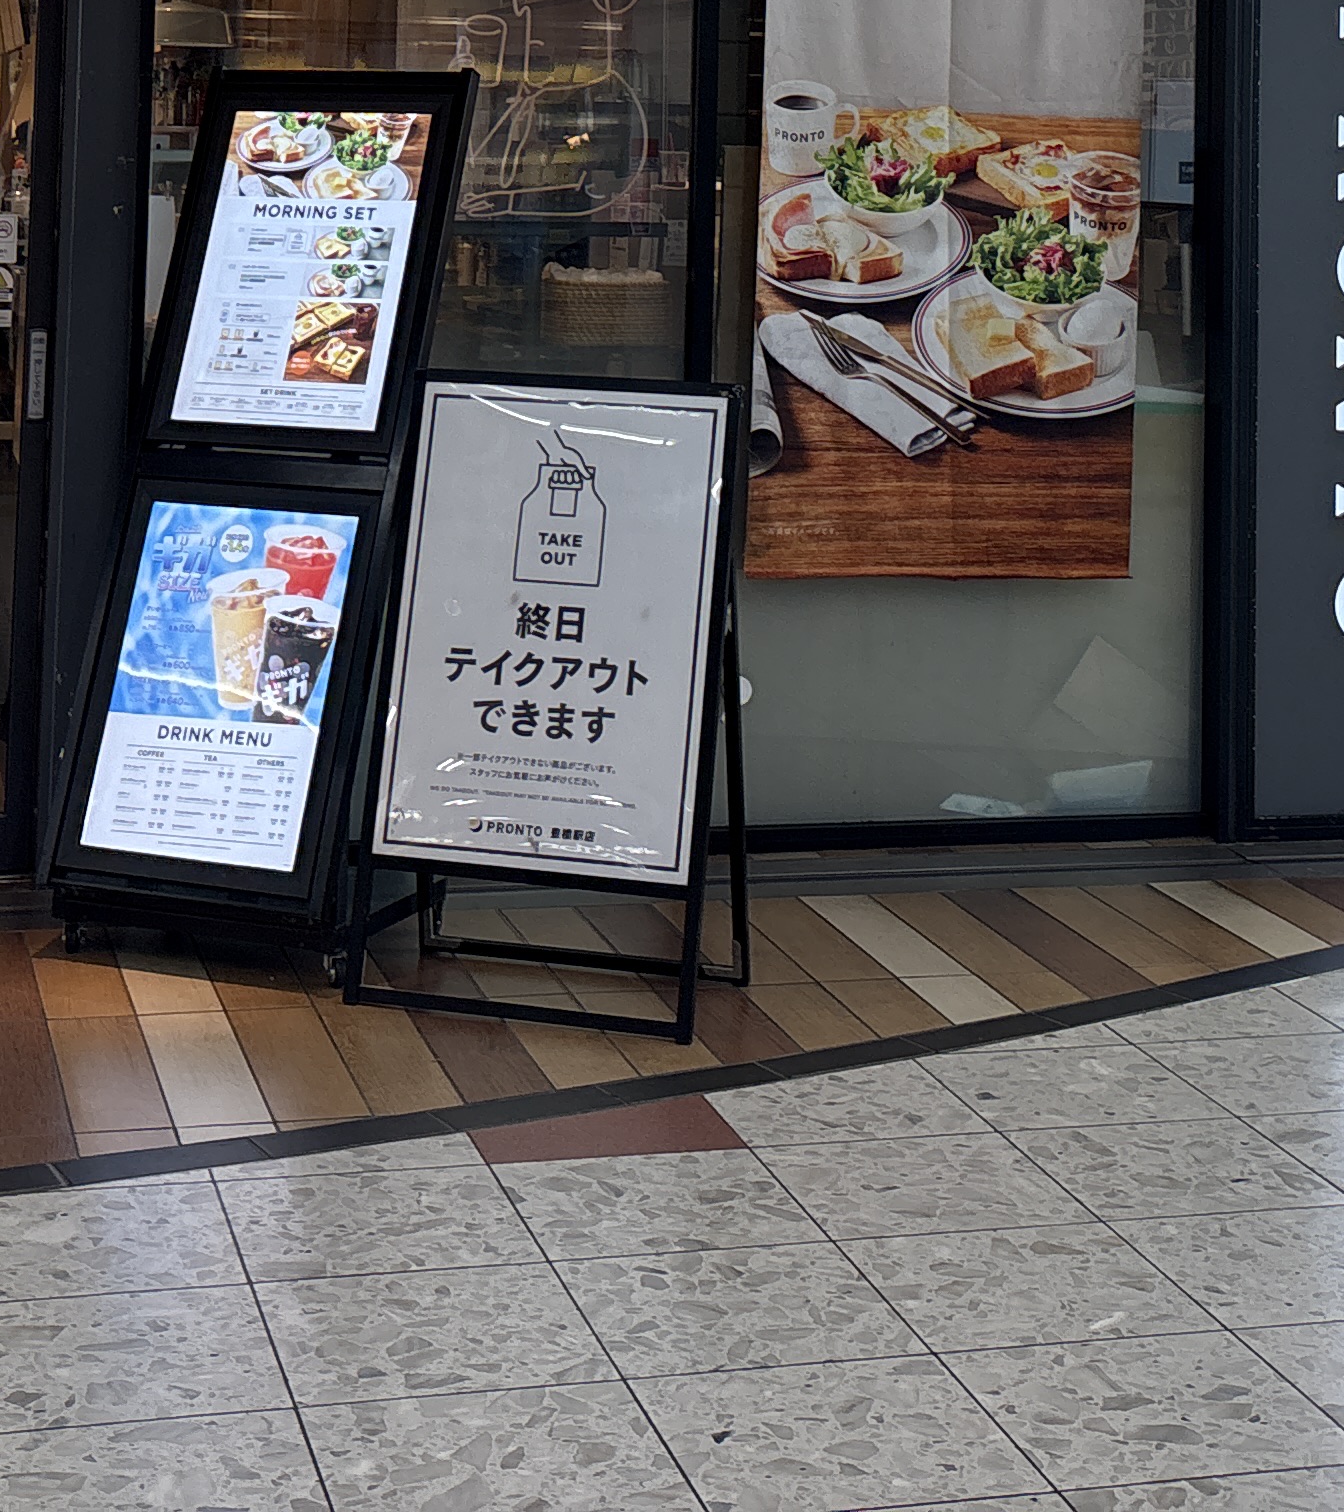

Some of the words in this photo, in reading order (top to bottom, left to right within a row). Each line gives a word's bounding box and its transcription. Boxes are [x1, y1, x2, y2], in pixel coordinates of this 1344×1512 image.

[774, 126, 826, 145] PRONTO
[252, 203, 338, 221] MORNING
[342, 205, 378, 221] SET
[1073, 210, 1129, 233] PRONTO
[537, 530, 583, 548] TAKE
[540, 550, 578, 567] OUT
[157, 572, 202, 592] SIZE
[515, 602, 587, 644] 終日
[263, 665, 301, 681] PRONTO
[442, 645, 649, 696] テイクアウト
[472, 698, 617, 743] できます
[157, 724, 216, 744] DRINK
[219, 729, 273, 748] MENU
[137, 749, 165, 759] COFFEE
[204, 754, 218, 763] TEA
[256, 759, 285, 768] OTHERS
[486, 820, 543, 837] PRONTO
